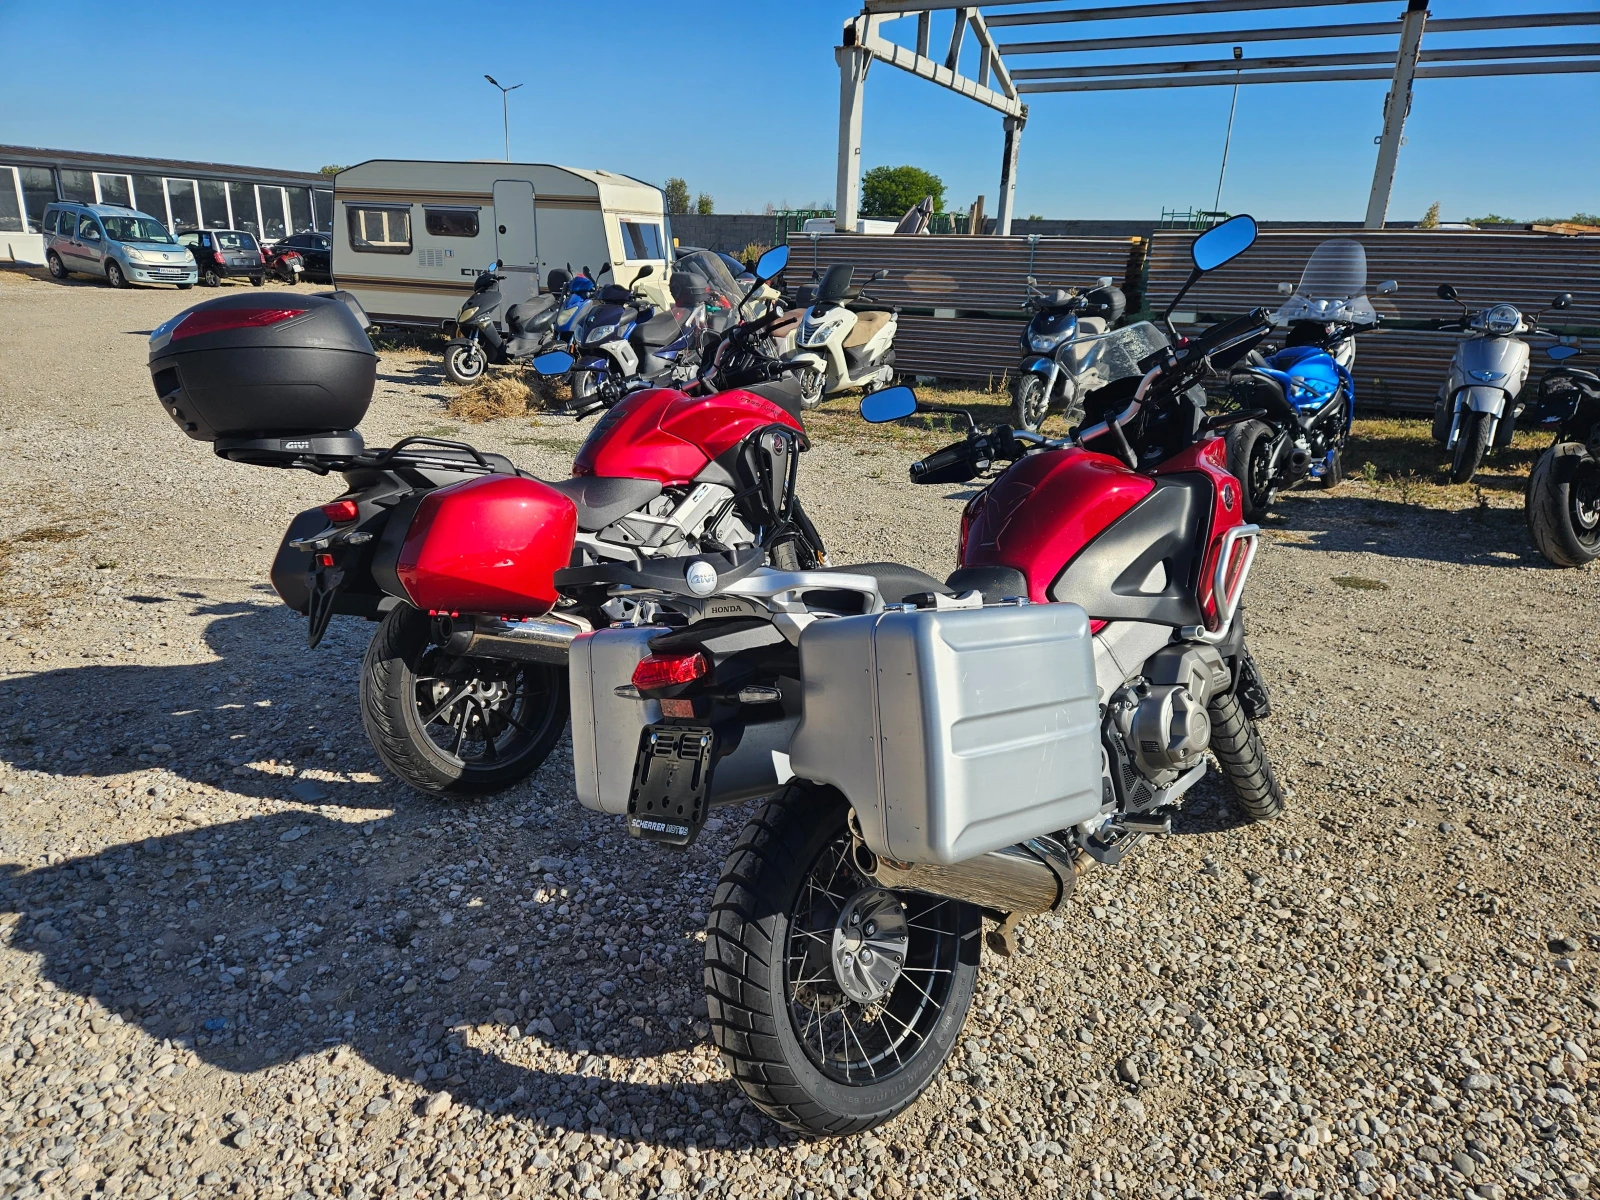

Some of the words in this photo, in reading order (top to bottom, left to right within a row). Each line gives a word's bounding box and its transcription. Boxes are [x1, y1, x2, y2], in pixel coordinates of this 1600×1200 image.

[285, 441, 309, 449] GIVI
[711, 605, 742, 613] HONDA
[631, 818, 666, 832] SCHERRER
